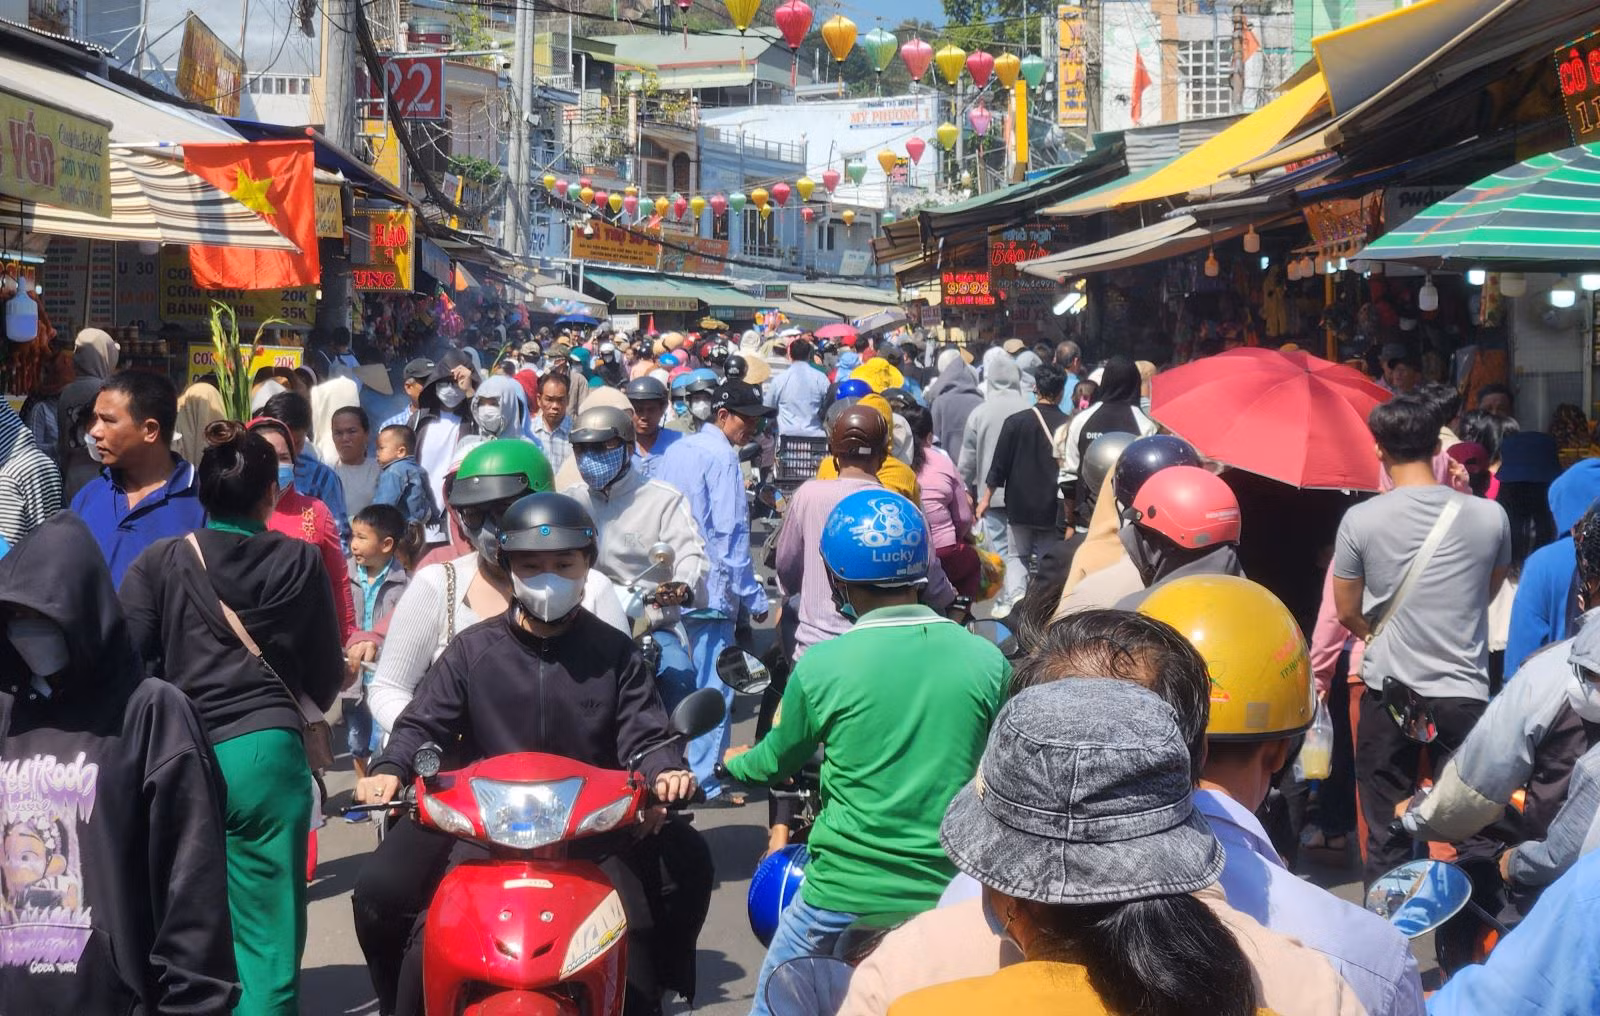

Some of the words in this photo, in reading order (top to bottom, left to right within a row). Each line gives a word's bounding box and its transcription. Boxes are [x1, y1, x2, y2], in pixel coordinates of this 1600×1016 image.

[281, 290, 307, 302] 20K
[281, 307, 307, 320] 35K
[872, 549, 915, 564] Lucky
